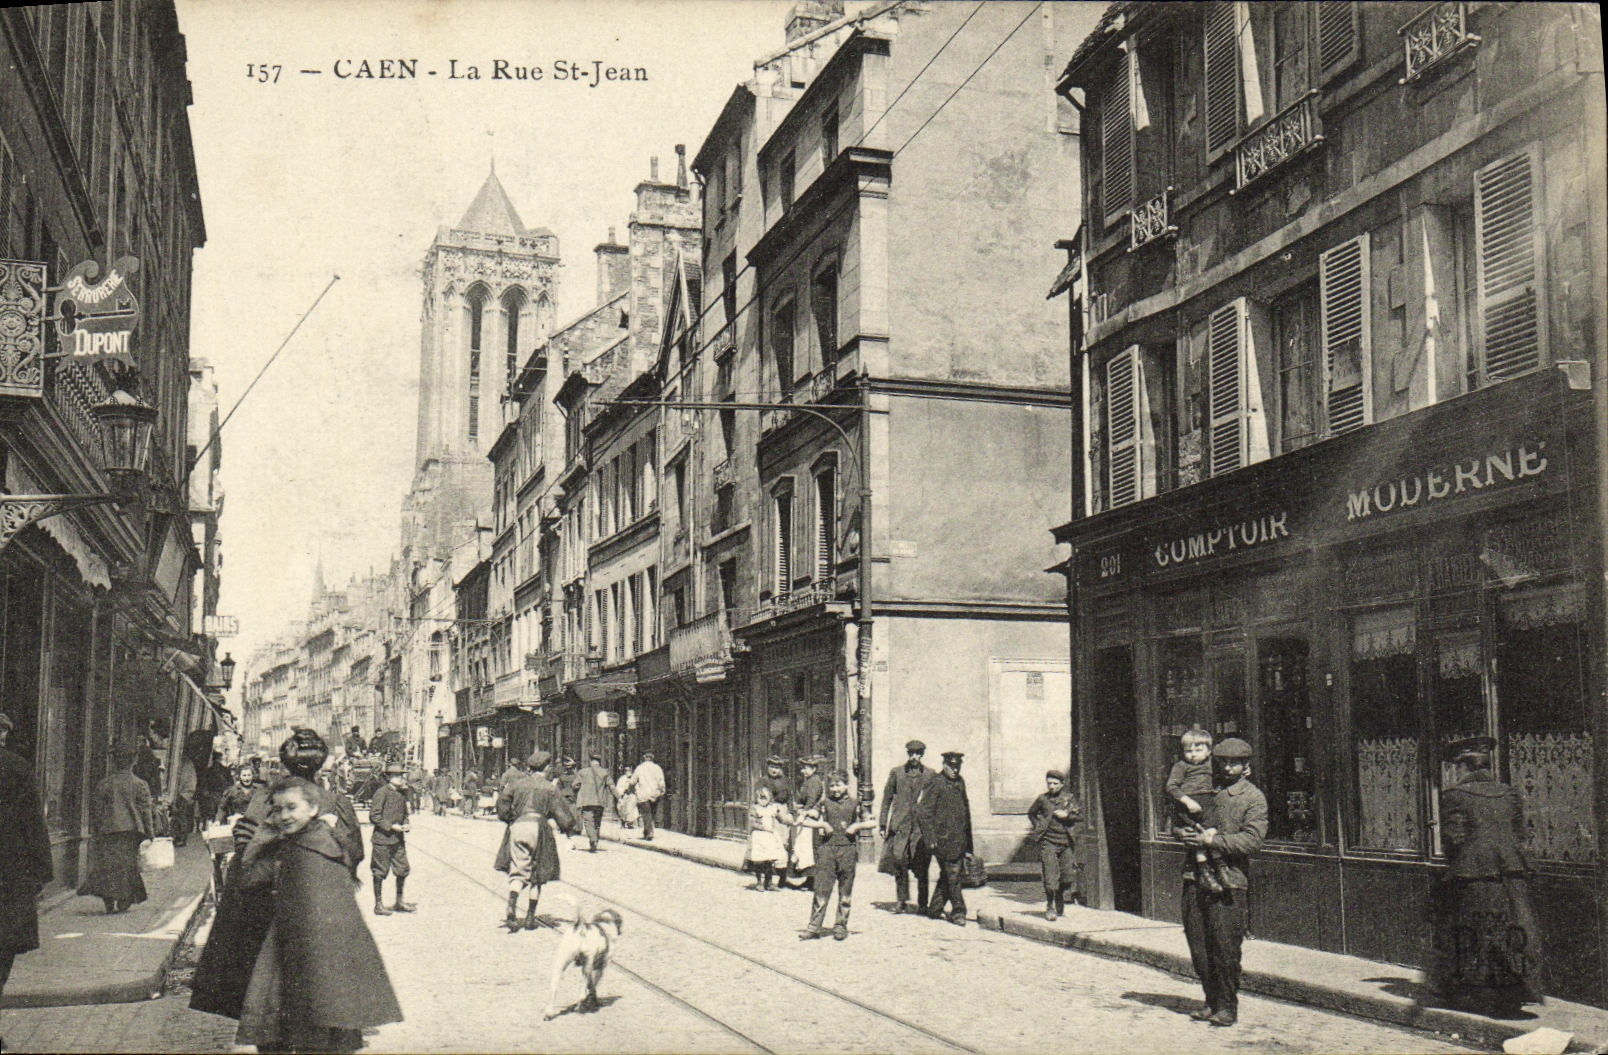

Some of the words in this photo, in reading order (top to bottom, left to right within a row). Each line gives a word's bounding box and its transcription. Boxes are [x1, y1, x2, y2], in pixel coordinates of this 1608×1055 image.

[73, 328, 131, 355] DUPONT
[1155, 516, 1290, 567] COMPTOIR
[1346, 440, 1548, 521] MODERNE
[1099, 554, 1122, 579] 201
